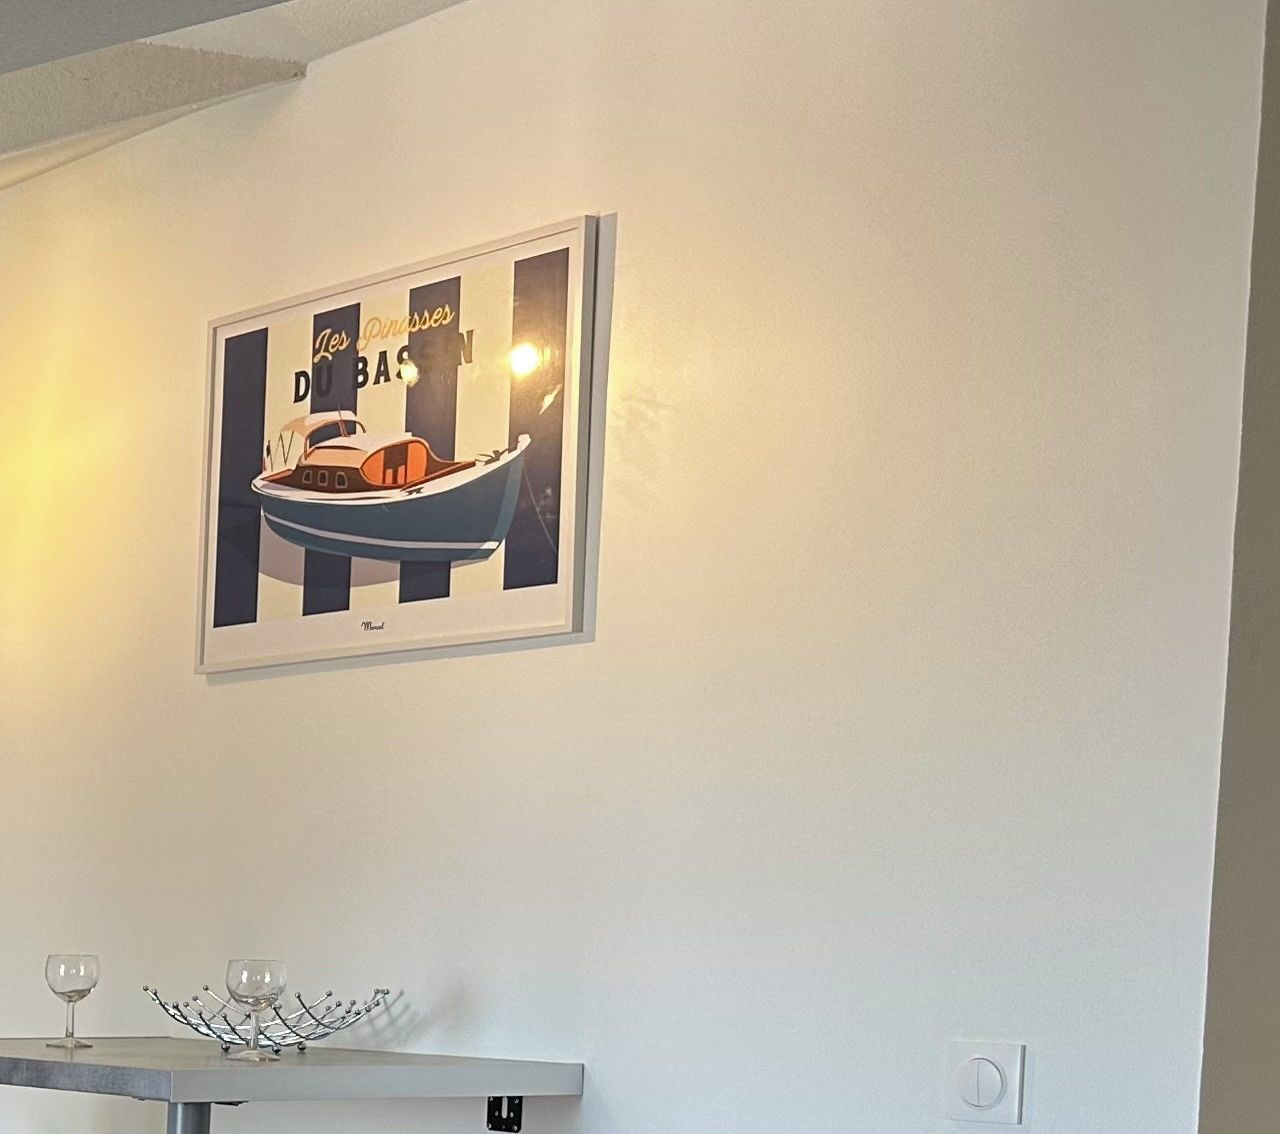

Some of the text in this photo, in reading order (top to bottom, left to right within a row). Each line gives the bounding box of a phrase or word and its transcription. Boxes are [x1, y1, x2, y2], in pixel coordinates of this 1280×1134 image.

[313, 304, 455, 363] Les Pinasses
[293, 364, 334, 404] DU
